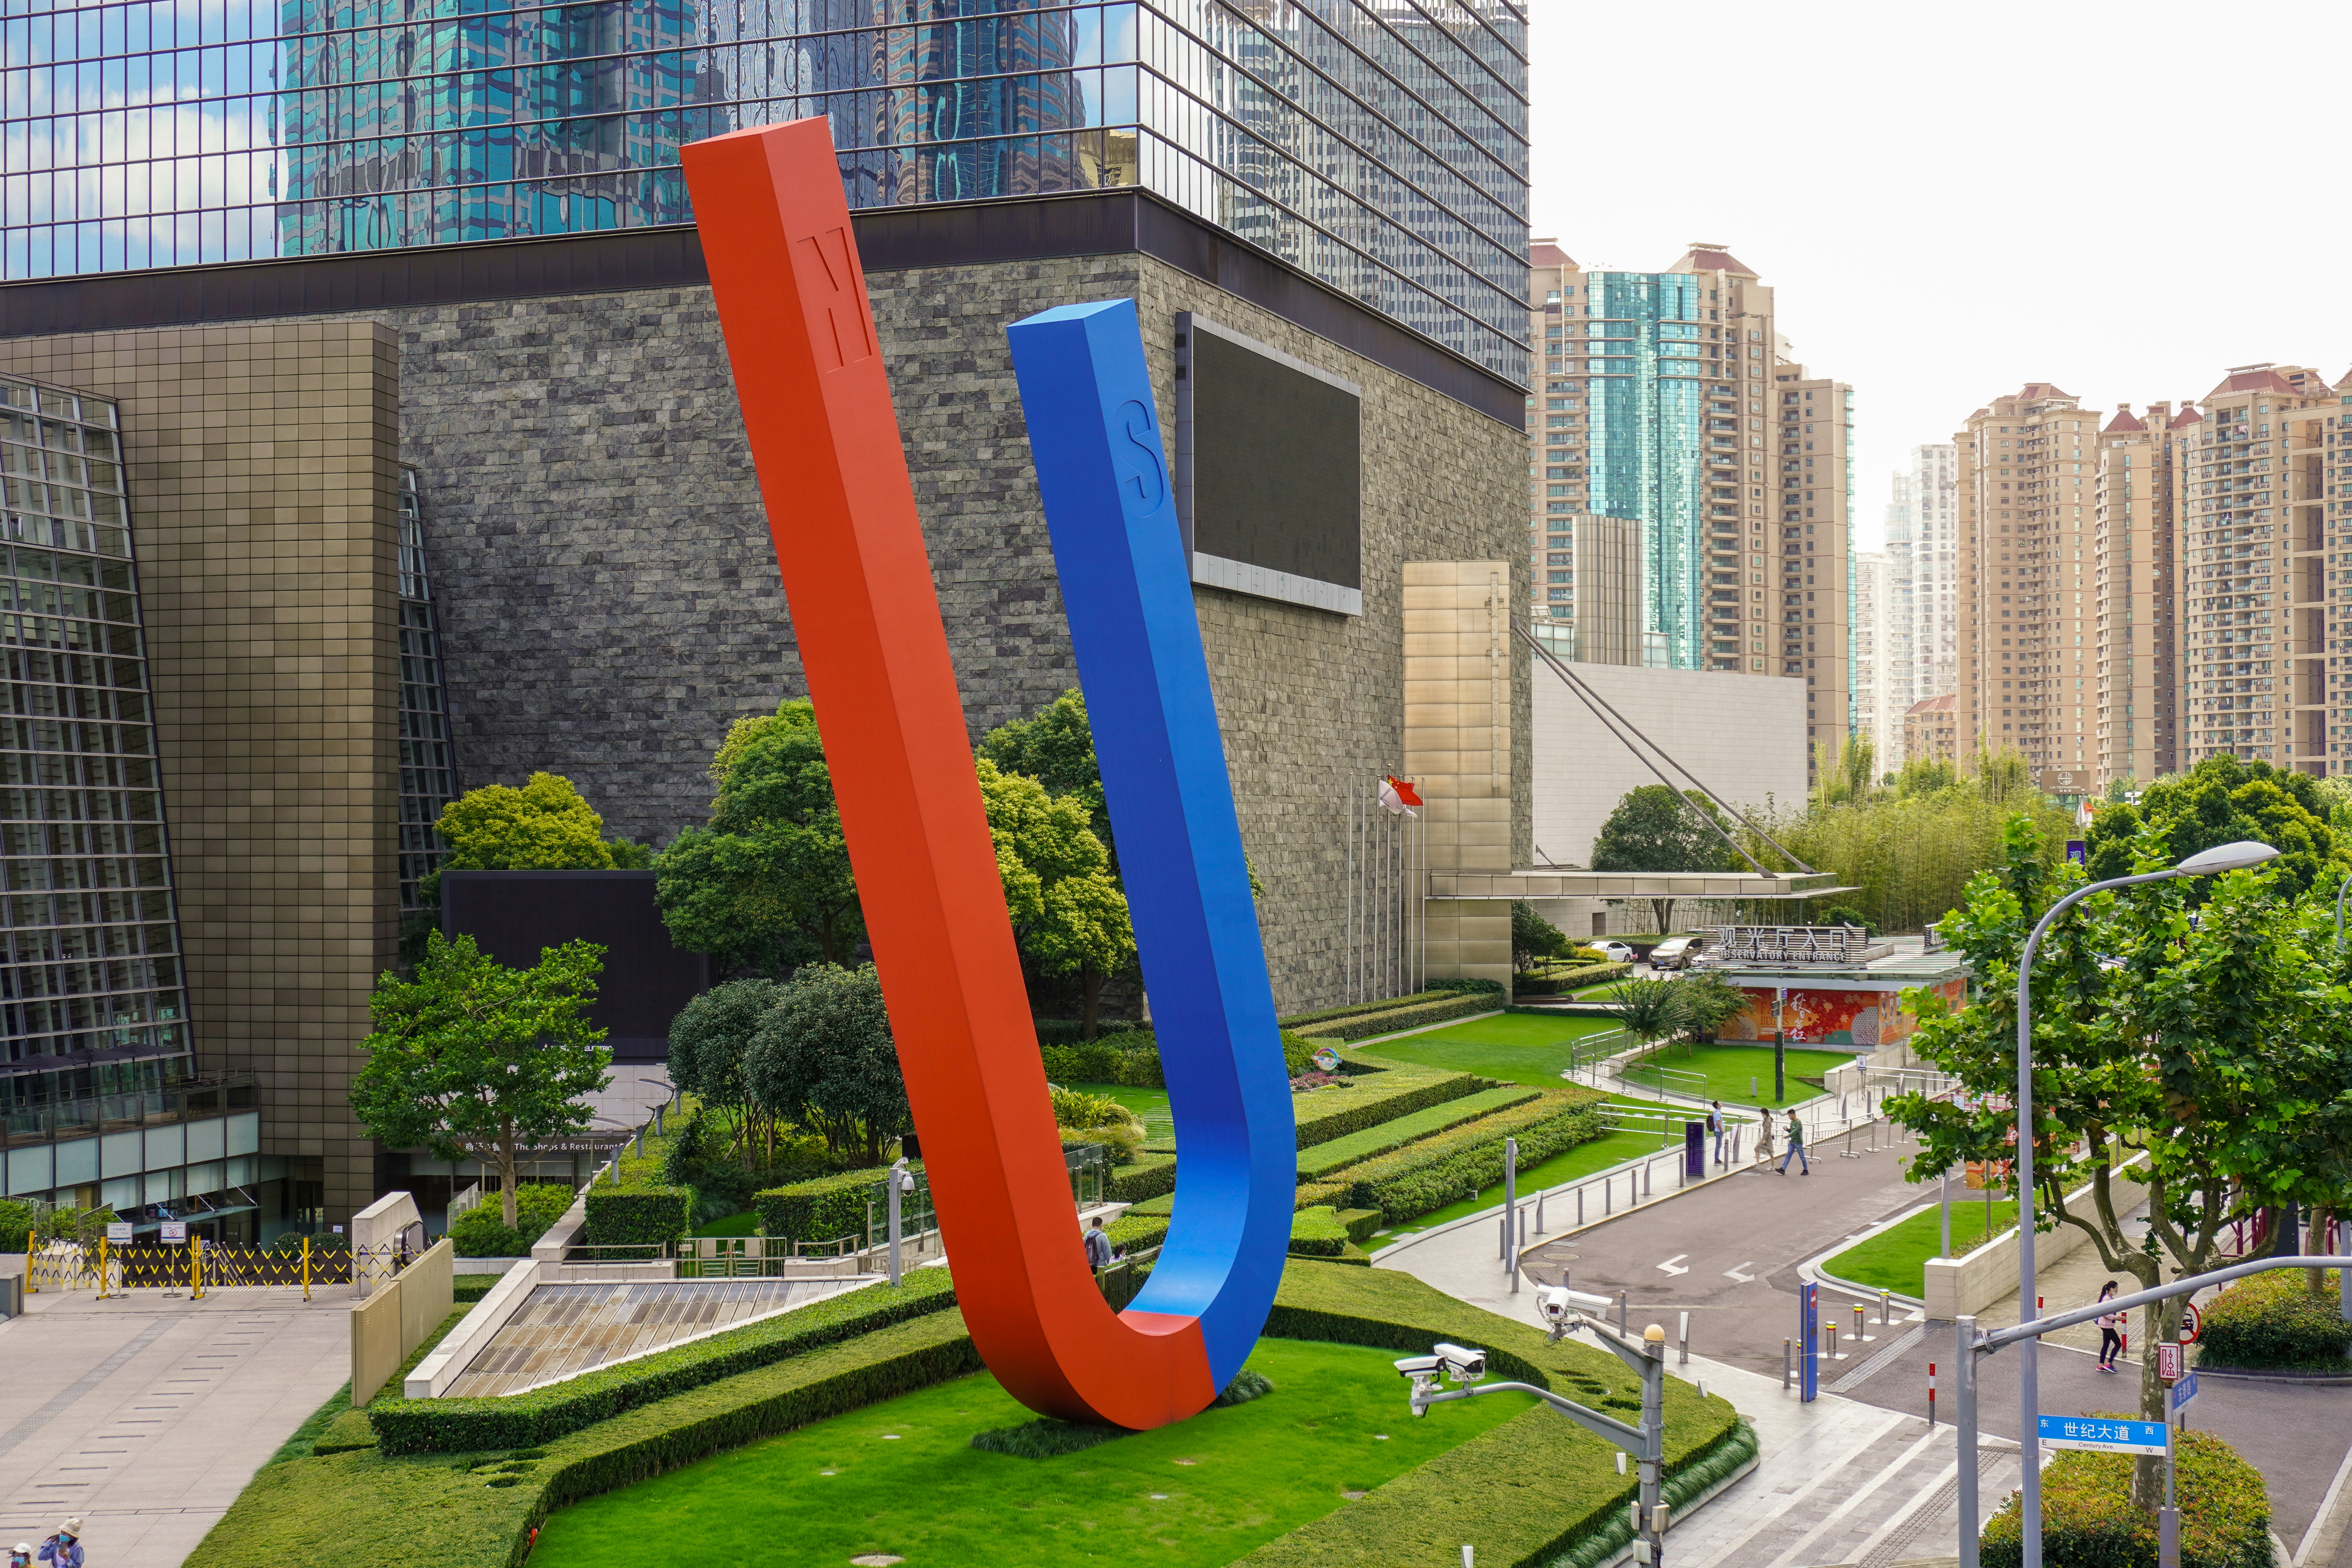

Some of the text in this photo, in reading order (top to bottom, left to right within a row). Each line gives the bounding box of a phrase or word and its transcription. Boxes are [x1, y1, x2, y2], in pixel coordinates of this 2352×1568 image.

[797, 227, 872, 373] N
[1116, 400, 1163, 517] S
[1719, 927, 1846, 949] 观光厅入口
[1718, 950, 1846, 961] OBSERVATORY ENTRANCE
[1760, 1002, 1789, 1015] FL
[1761, 1016, 1789, 1026] BEGS
[2040, 1419, 2154, 1441] 东 世纪大道 西
